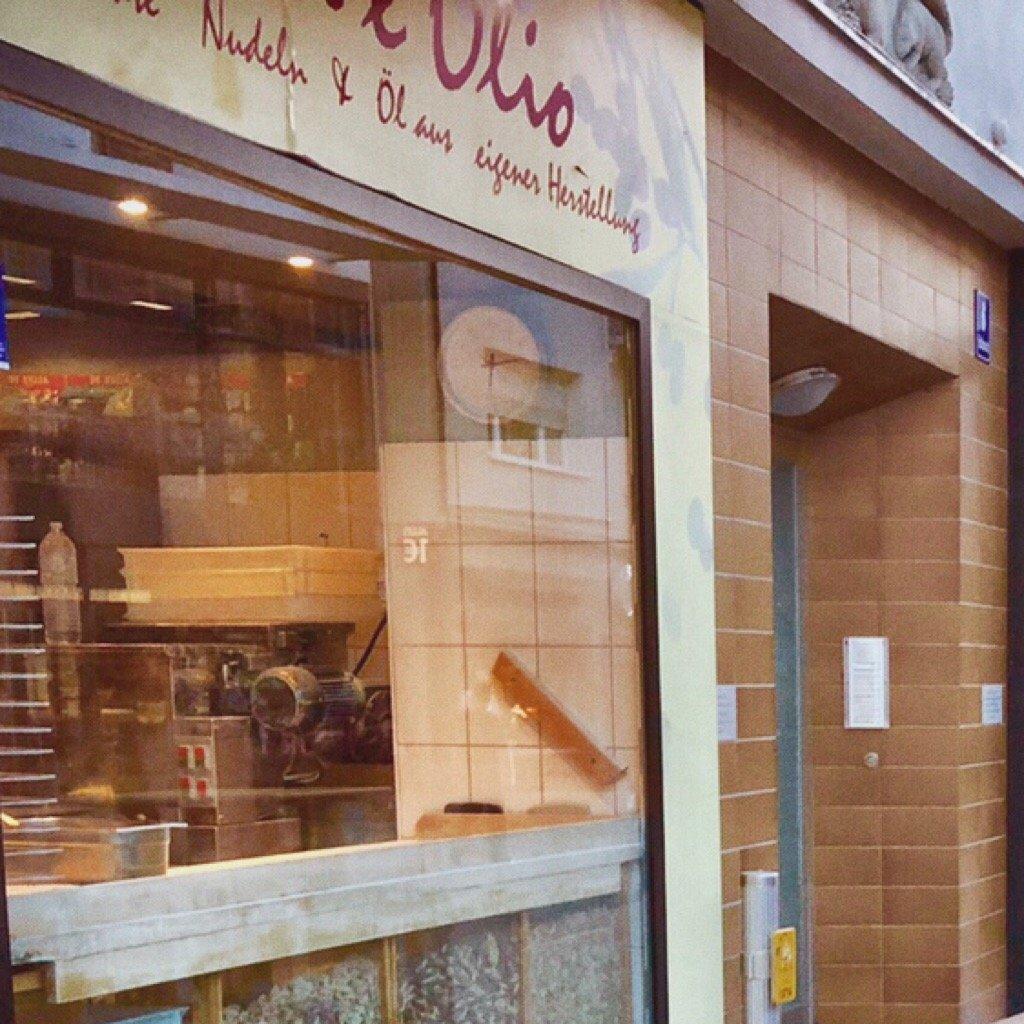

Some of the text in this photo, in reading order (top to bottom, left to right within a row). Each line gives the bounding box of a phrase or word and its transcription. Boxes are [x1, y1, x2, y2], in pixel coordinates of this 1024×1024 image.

[201, 0, 308, 84] Nudeln
[376, 67, 406, 129] Öl
[474, 139, 541, 196] eigener
[548, 161, 641, 254] Herstellung
[430, 0, 575, 148] Olio
